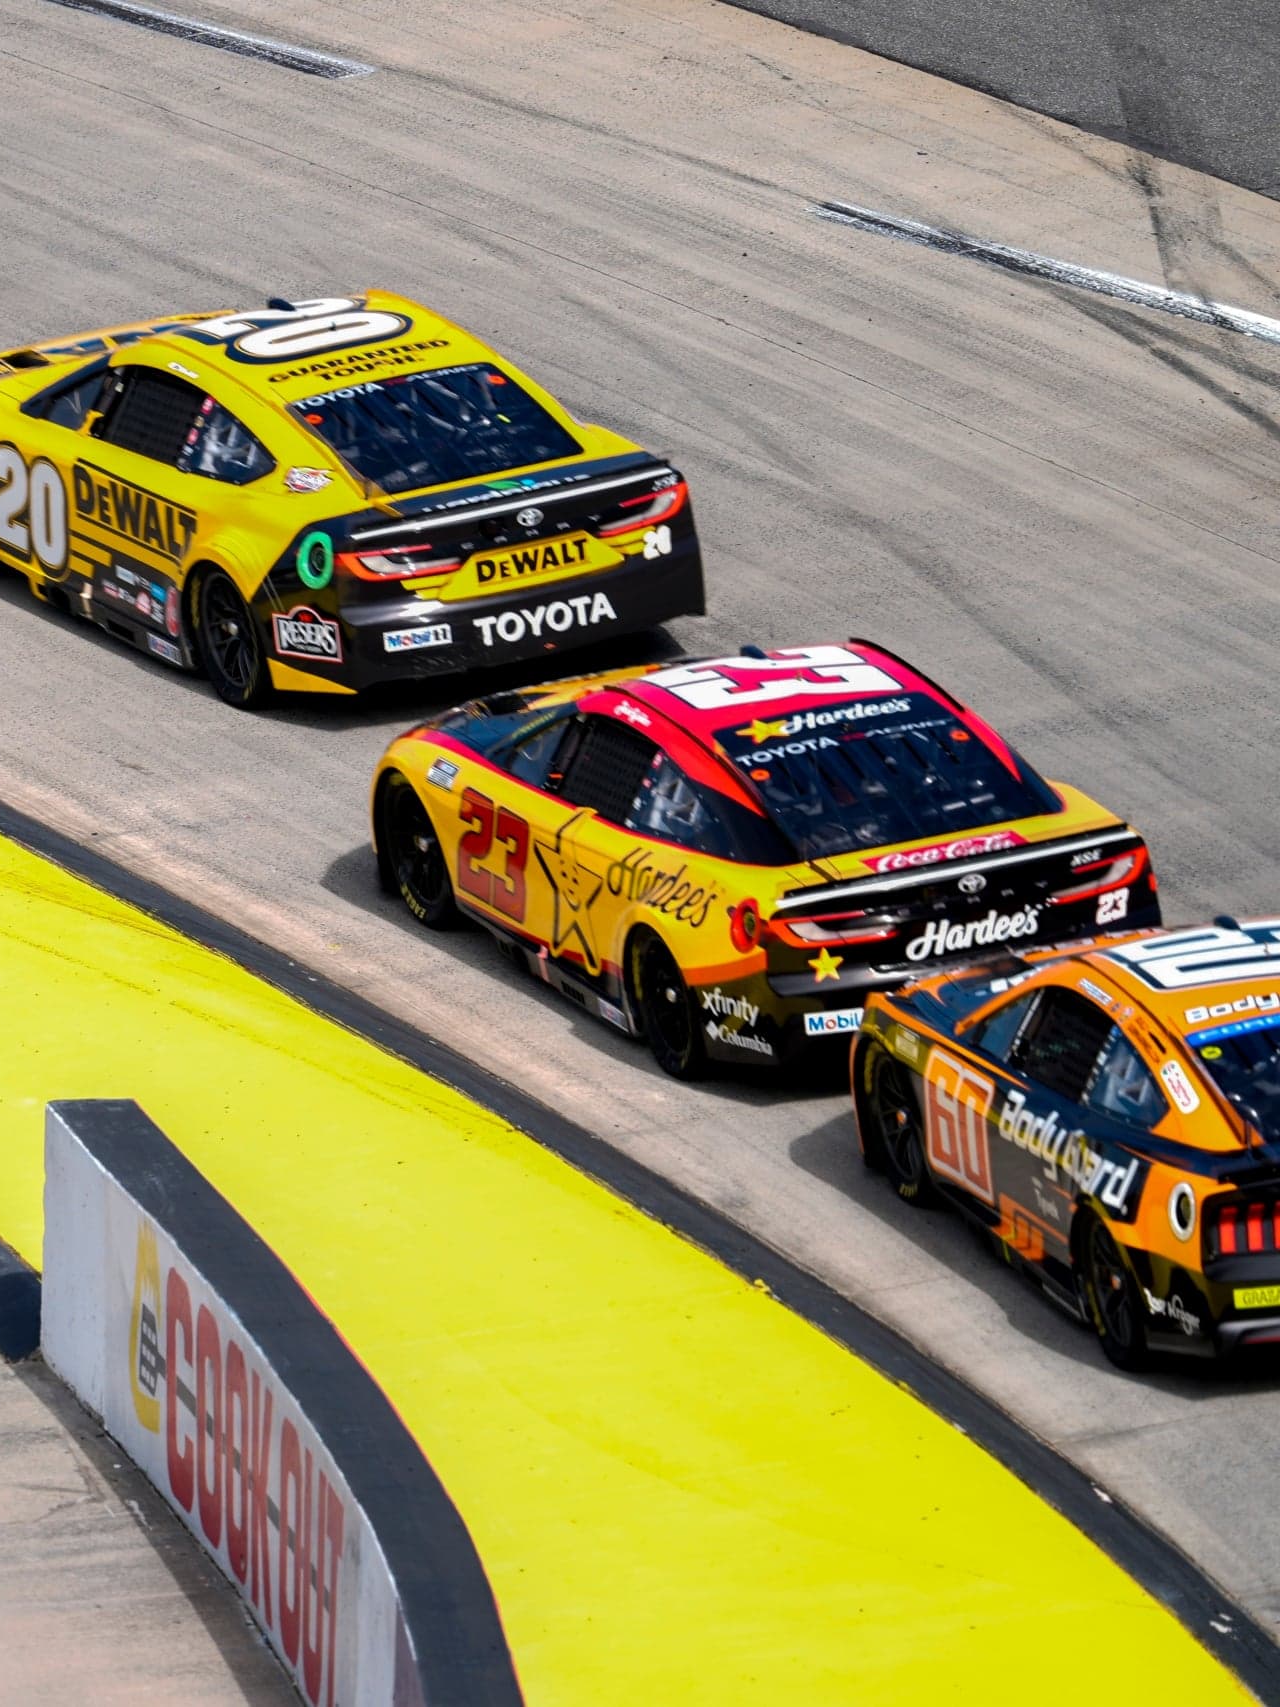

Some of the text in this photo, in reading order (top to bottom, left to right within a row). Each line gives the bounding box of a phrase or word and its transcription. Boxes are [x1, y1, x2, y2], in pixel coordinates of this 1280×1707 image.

[269, 339, 450, 383] GUARANTEED
[294, 382, 384, 410] TOYOTA
[473, 592, 618, 647] TOYOTA
[780, 698, 911, 734] Hardee's
[736, 736, 840, 767] TOYOTA
[458, 787, 531, 924] 23
[1096, 888, 1130, 925] 23
[905, 903, 1039, 961] Hardee's
[702, 987, 760, 1027] xfinity
[808, 1012, 862, 1032] Mobil
[719, 1025, 774, 1056] Columbia
[926, 1047, 995, 1204] 60
[166, 1266, 345, 1707] COOK OUT
